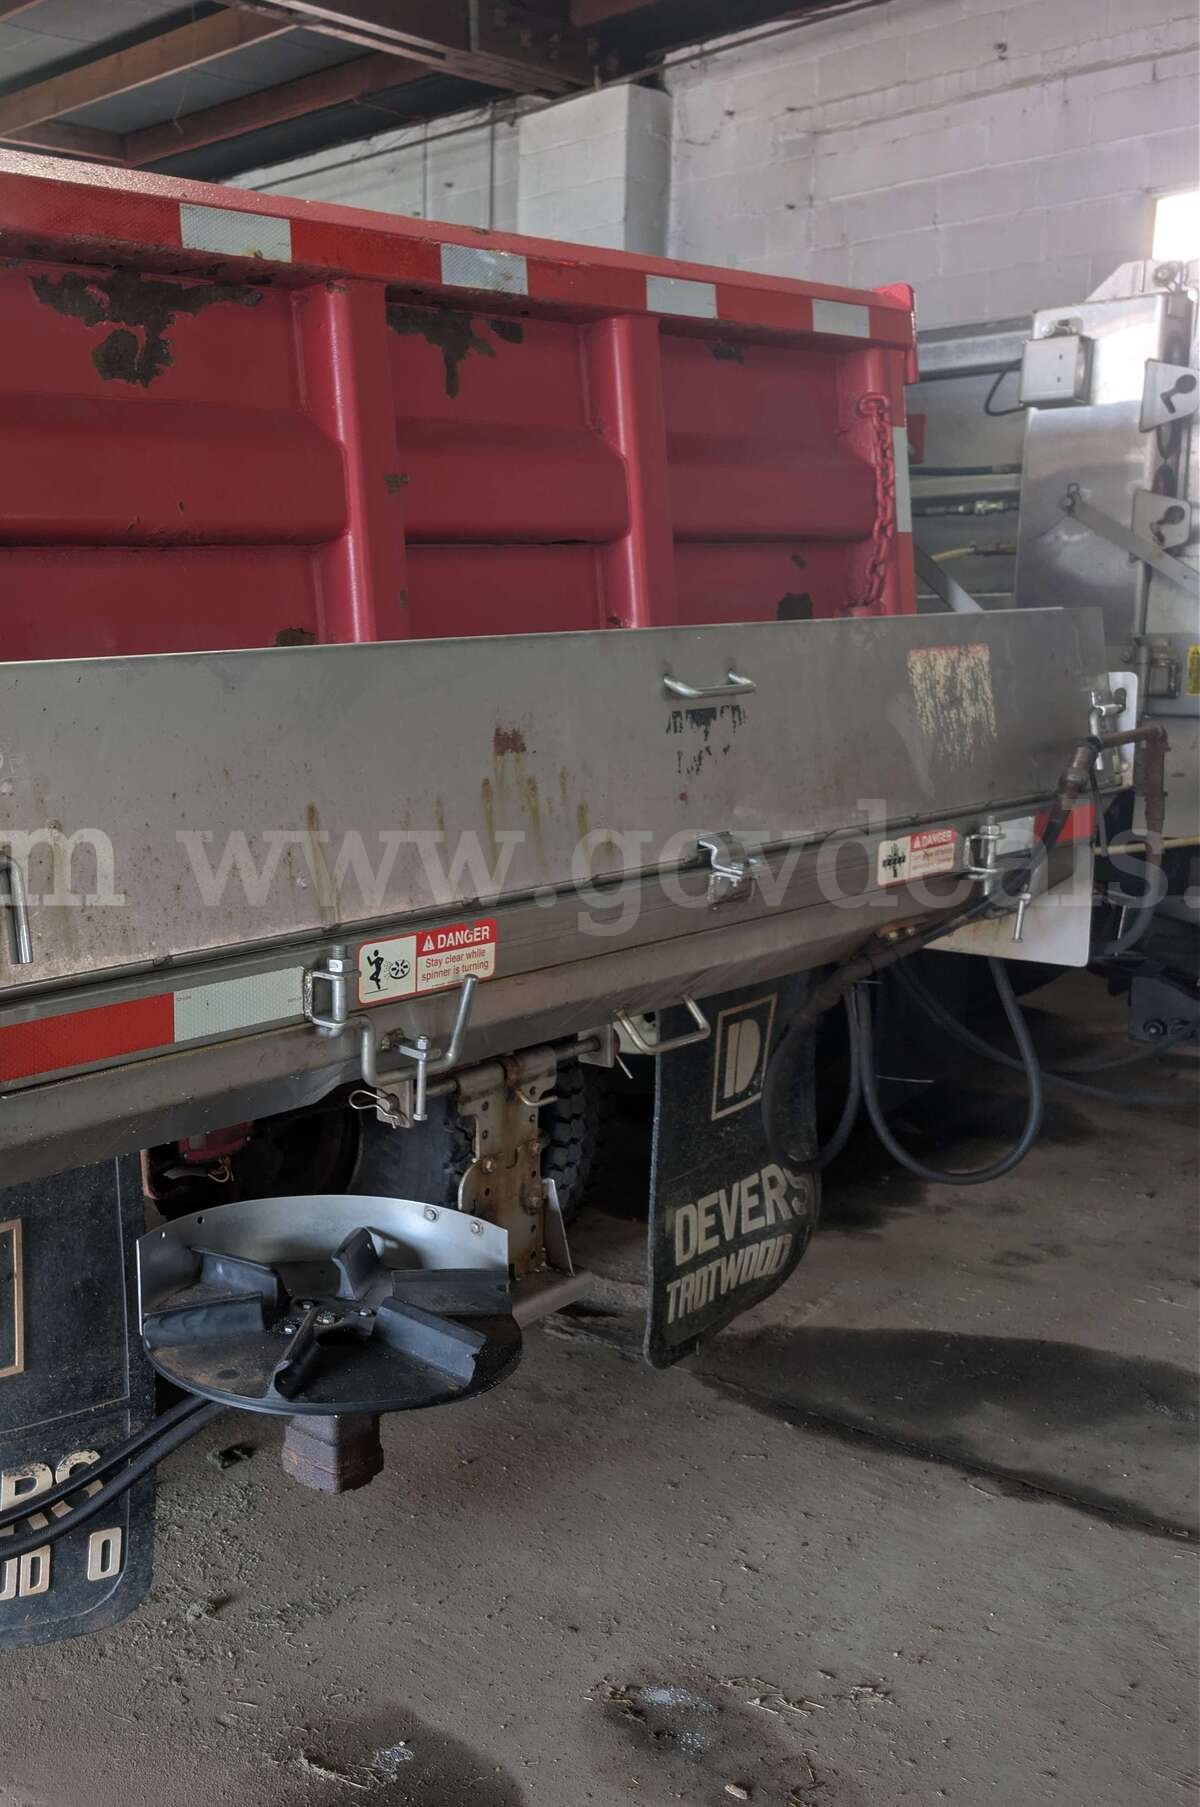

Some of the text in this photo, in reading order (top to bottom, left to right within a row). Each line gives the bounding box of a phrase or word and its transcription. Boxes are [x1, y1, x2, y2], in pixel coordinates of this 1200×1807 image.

[921, 830, 952, 848] DANGER
[437, 925, 490, 949] DANGER
[425, 948, 487, 969] Stay clear while
[421, 959, 489, 983] spinner is turning
